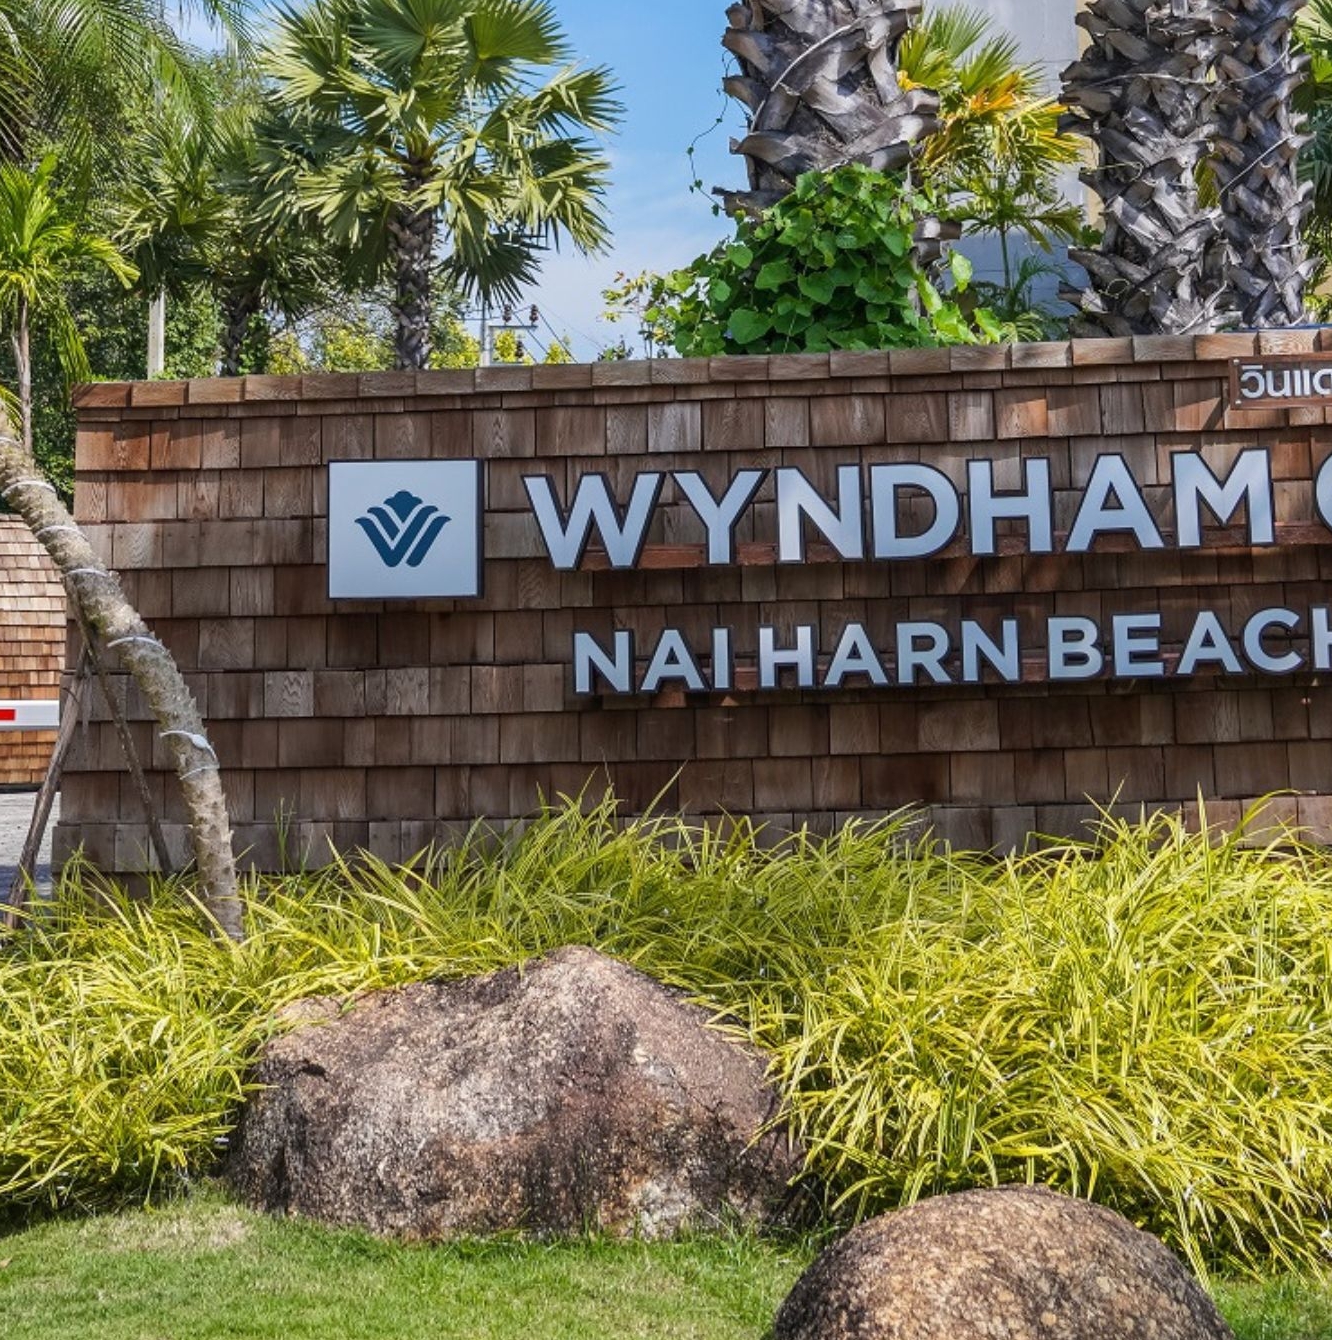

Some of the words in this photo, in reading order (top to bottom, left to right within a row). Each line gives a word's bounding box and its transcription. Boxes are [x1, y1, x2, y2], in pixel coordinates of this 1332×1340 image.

[521, 447, 1276, 571] WYNDHAM
[573, 624, 733, 695] NAI
[758, 616, 1023, 690] HARN
